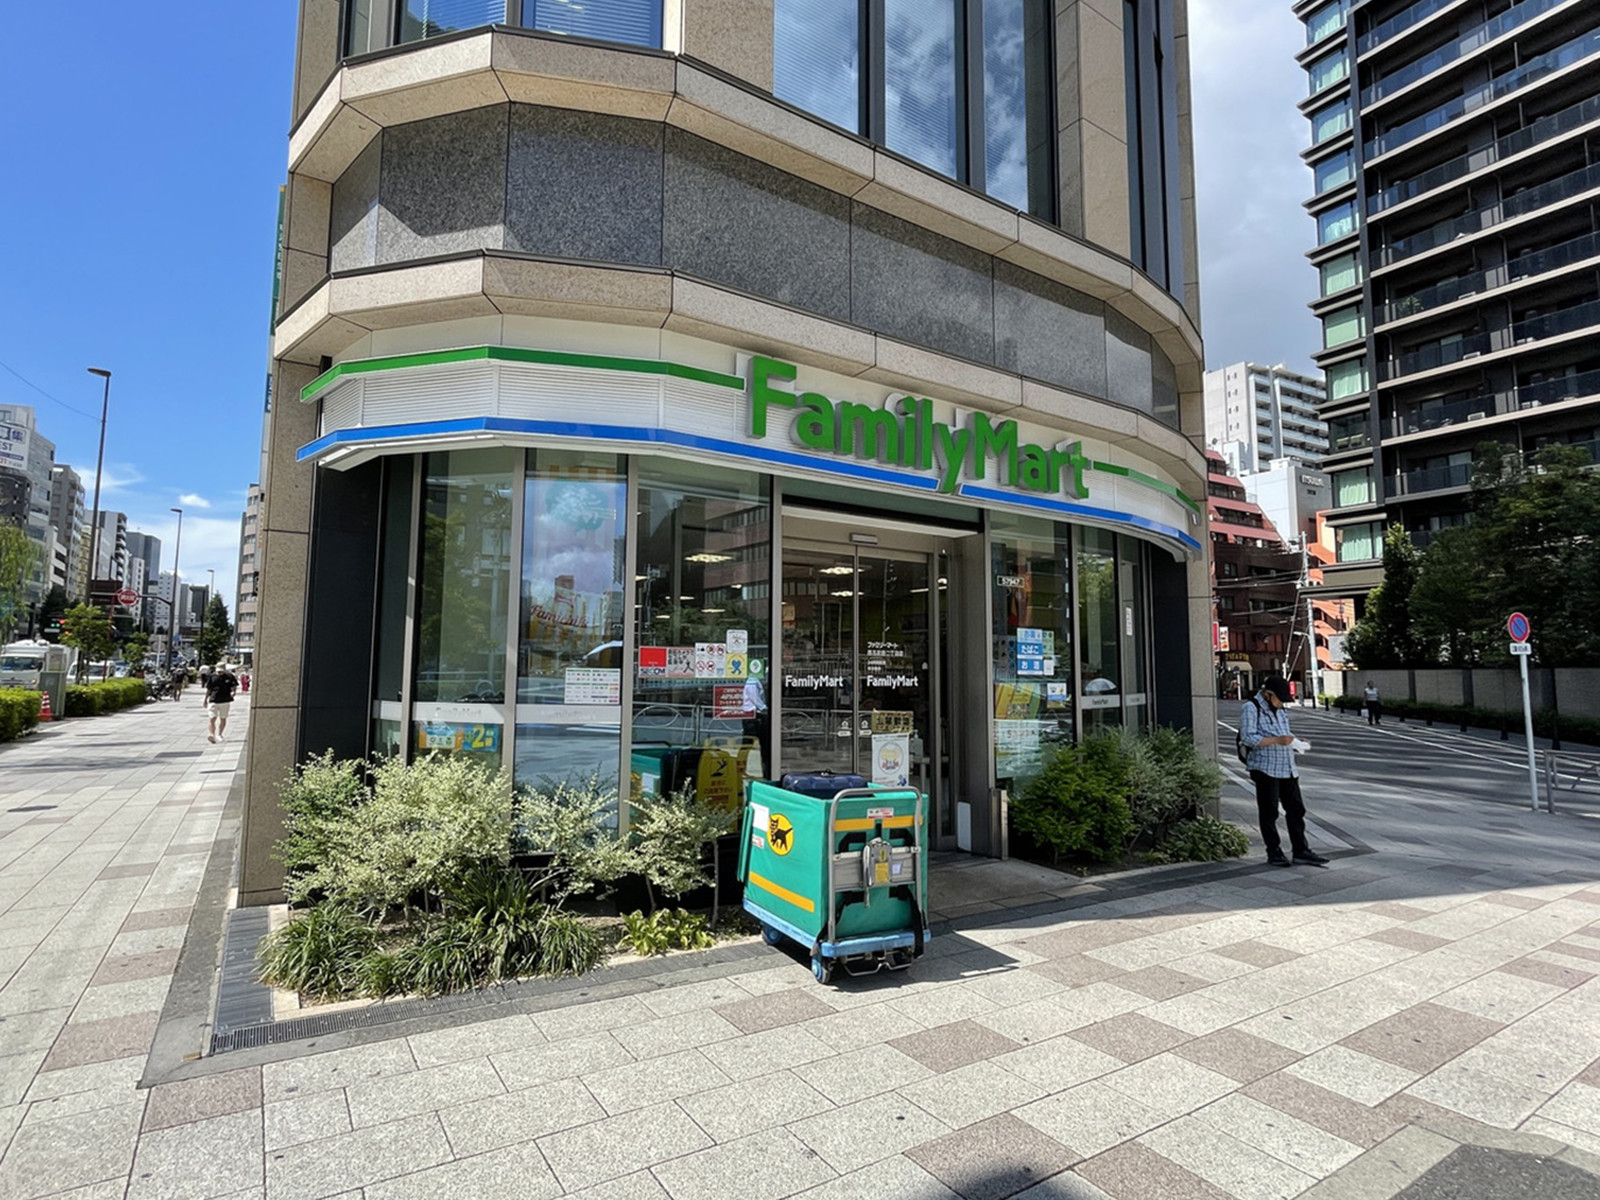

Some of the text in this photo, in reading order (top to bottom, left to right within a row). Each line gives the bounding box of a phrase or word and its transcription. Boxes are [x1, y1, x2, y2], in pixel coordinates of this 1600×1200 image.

[746, 355, 1090, 501] FamilyMart
[1021, 644, 1040, 654] たばこ
[785, 674, 843, 690] FamilyMart
[867, 675, 918, 689] FamilyMart
